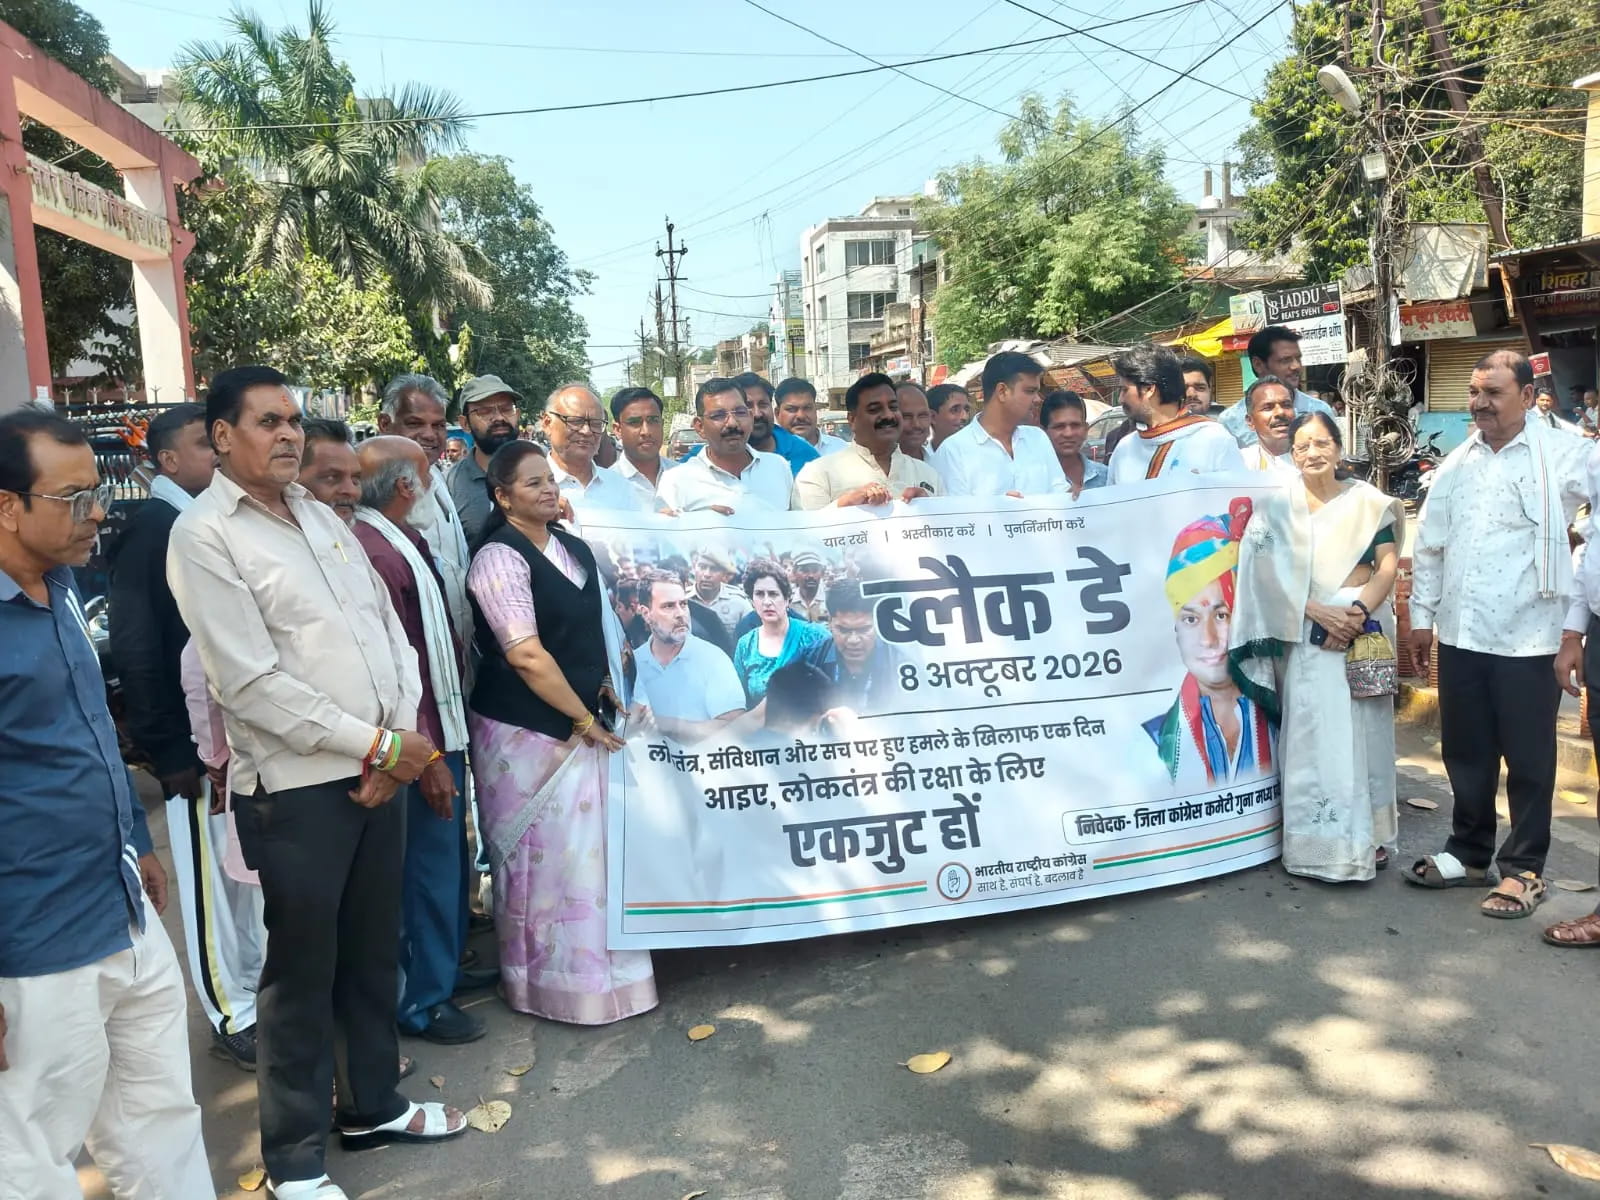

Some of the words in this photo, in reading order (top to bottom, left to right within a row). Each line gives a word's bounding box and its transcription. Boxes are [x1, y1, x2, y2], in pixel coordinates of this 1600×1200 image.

[1280, 288, 1320, 310] LADDU
[1301, 305, 1321, 317] EVENT
[902, 524, 954, 541] अस्वीकार
[957, 523, 975, 537] करें
[1065, 516, 1086, 530] करें
[824, 537, 846, 549] याद
[847, 531, 868, 545] रखें
[862, 554, 1055, 646] ब्लैक
[1066, 546, 1132, 635] डे
[899, 664, 919, 691] 8
[926, 655, 1037, 697] अक्टूबर
[1043, 649, 1122, 681] 2026
[648, 740, 704, 774] लोतंत्र,
[707, 745, 781, 770] संविधान
[785, 739, 818, 763] और
[819, 741, 850, 760] सच
[853, 739, 878, 757] पर
[881, 736, 905, 761] हुए
[907, 729, 949, 754] हमले
[952, 728, 971, 749] के
[972, 724, 1039, 747] खिलाफ
[1041, 722, 1072, 739] एक
[1073, 716, 1106, 737] दिन
[704, 783, 776, 811] आइए,
[778, 769, 879, 802] लोकतंत्र
[882, 762, 916, 792] की
[919, 765, 964, 790] रक्षा
[966, 757, 992, 785] के
[995, 752, 1046, 782] लिए
[1075, 813, 1131, 837] निवेदक-
[1134, 808, 1166, 829] जिला
[1168, 801, 1203, 823] कांग्रेस
[1205, 792, 1234, 816] कमेटी
[1234, 791, 1254, 815] गुना
[1255, 785, 1273, 804] मध्य
[782, 810, 928, 875] एकजुट
[932, 792, 982, 850] हों
[975, 860, 1014, 877] भारतीय
[1015, 855, 1051, 872] राष्ट्रीय
[1051, 852, 1087, 867] कांग्रेस
[976, 881, 997, 892] साथ
[1043, 870, 1076, 884] बदलाव
